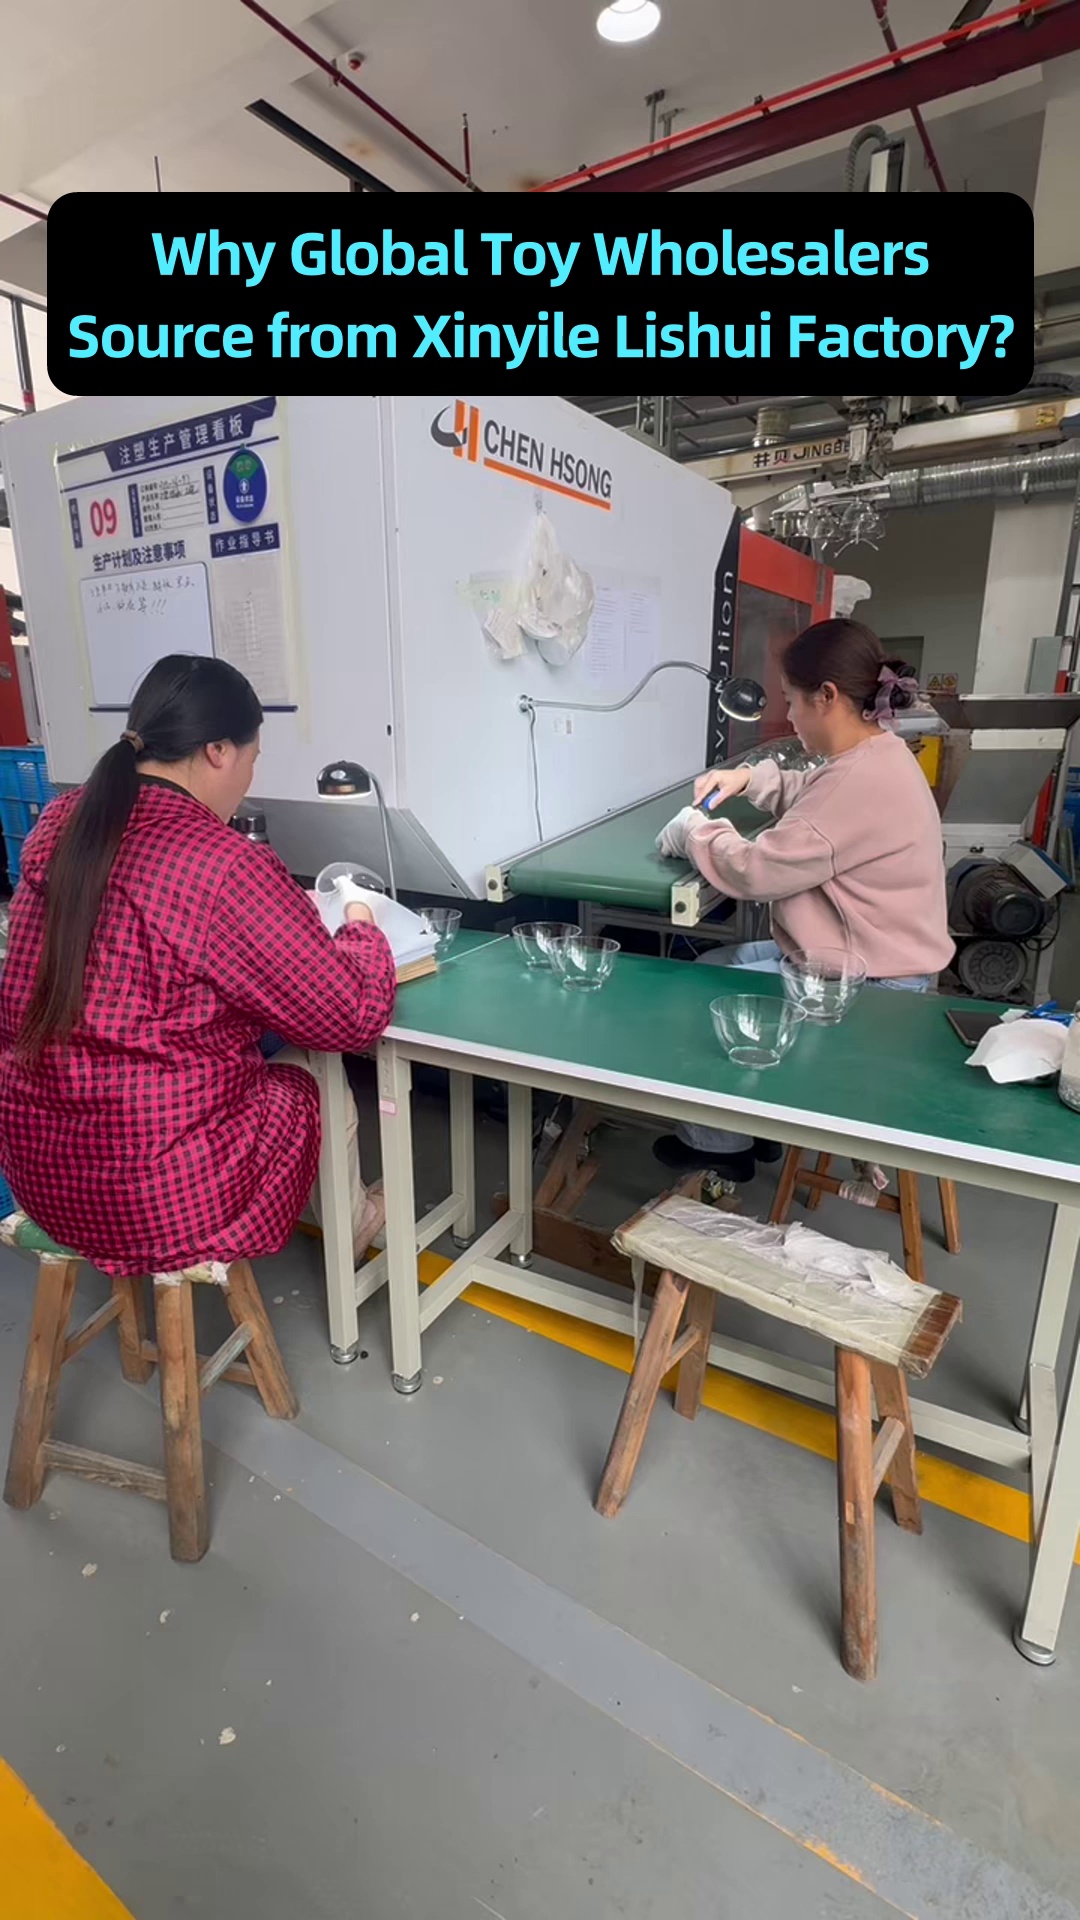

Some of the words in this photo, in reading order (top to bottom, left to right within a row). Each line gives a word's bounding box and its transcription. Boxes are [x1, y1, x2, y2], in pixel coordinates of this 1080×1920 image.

[118, 412, 244, 465] 注塑生产管理看板
[483, 419, 544, 472] CHEN
[550, 447, 612, 498] HSONG
[90, 498, 117, 537] 09
[93, 540, 186, 573] 生产计划及注意事项
[215, 529, 275, 553] 作业指导书
